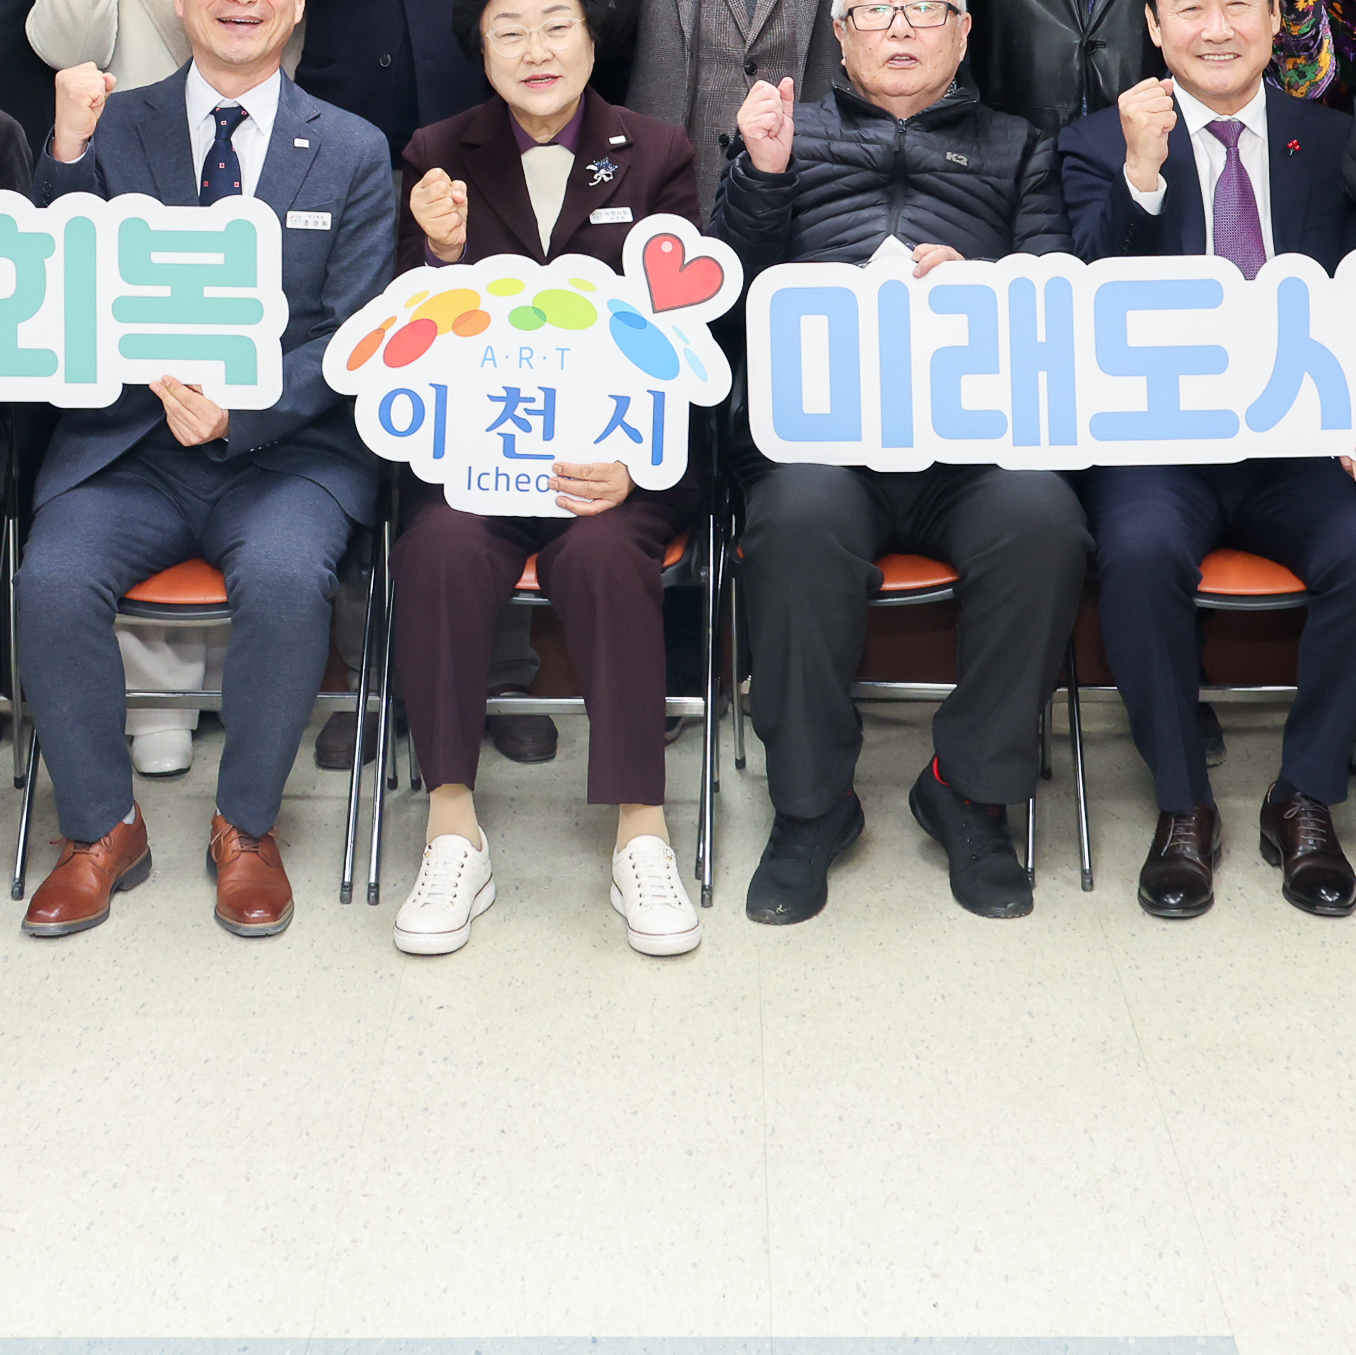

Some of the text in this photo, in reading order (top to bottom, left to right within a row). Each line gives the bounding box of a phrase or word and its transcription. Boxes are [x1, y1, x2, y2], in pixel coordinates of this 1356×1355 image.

[946, 151, 969, 166] K2
[378, 382, 666, 467] 이천시
[468, 466, 560, 493] Icheo
